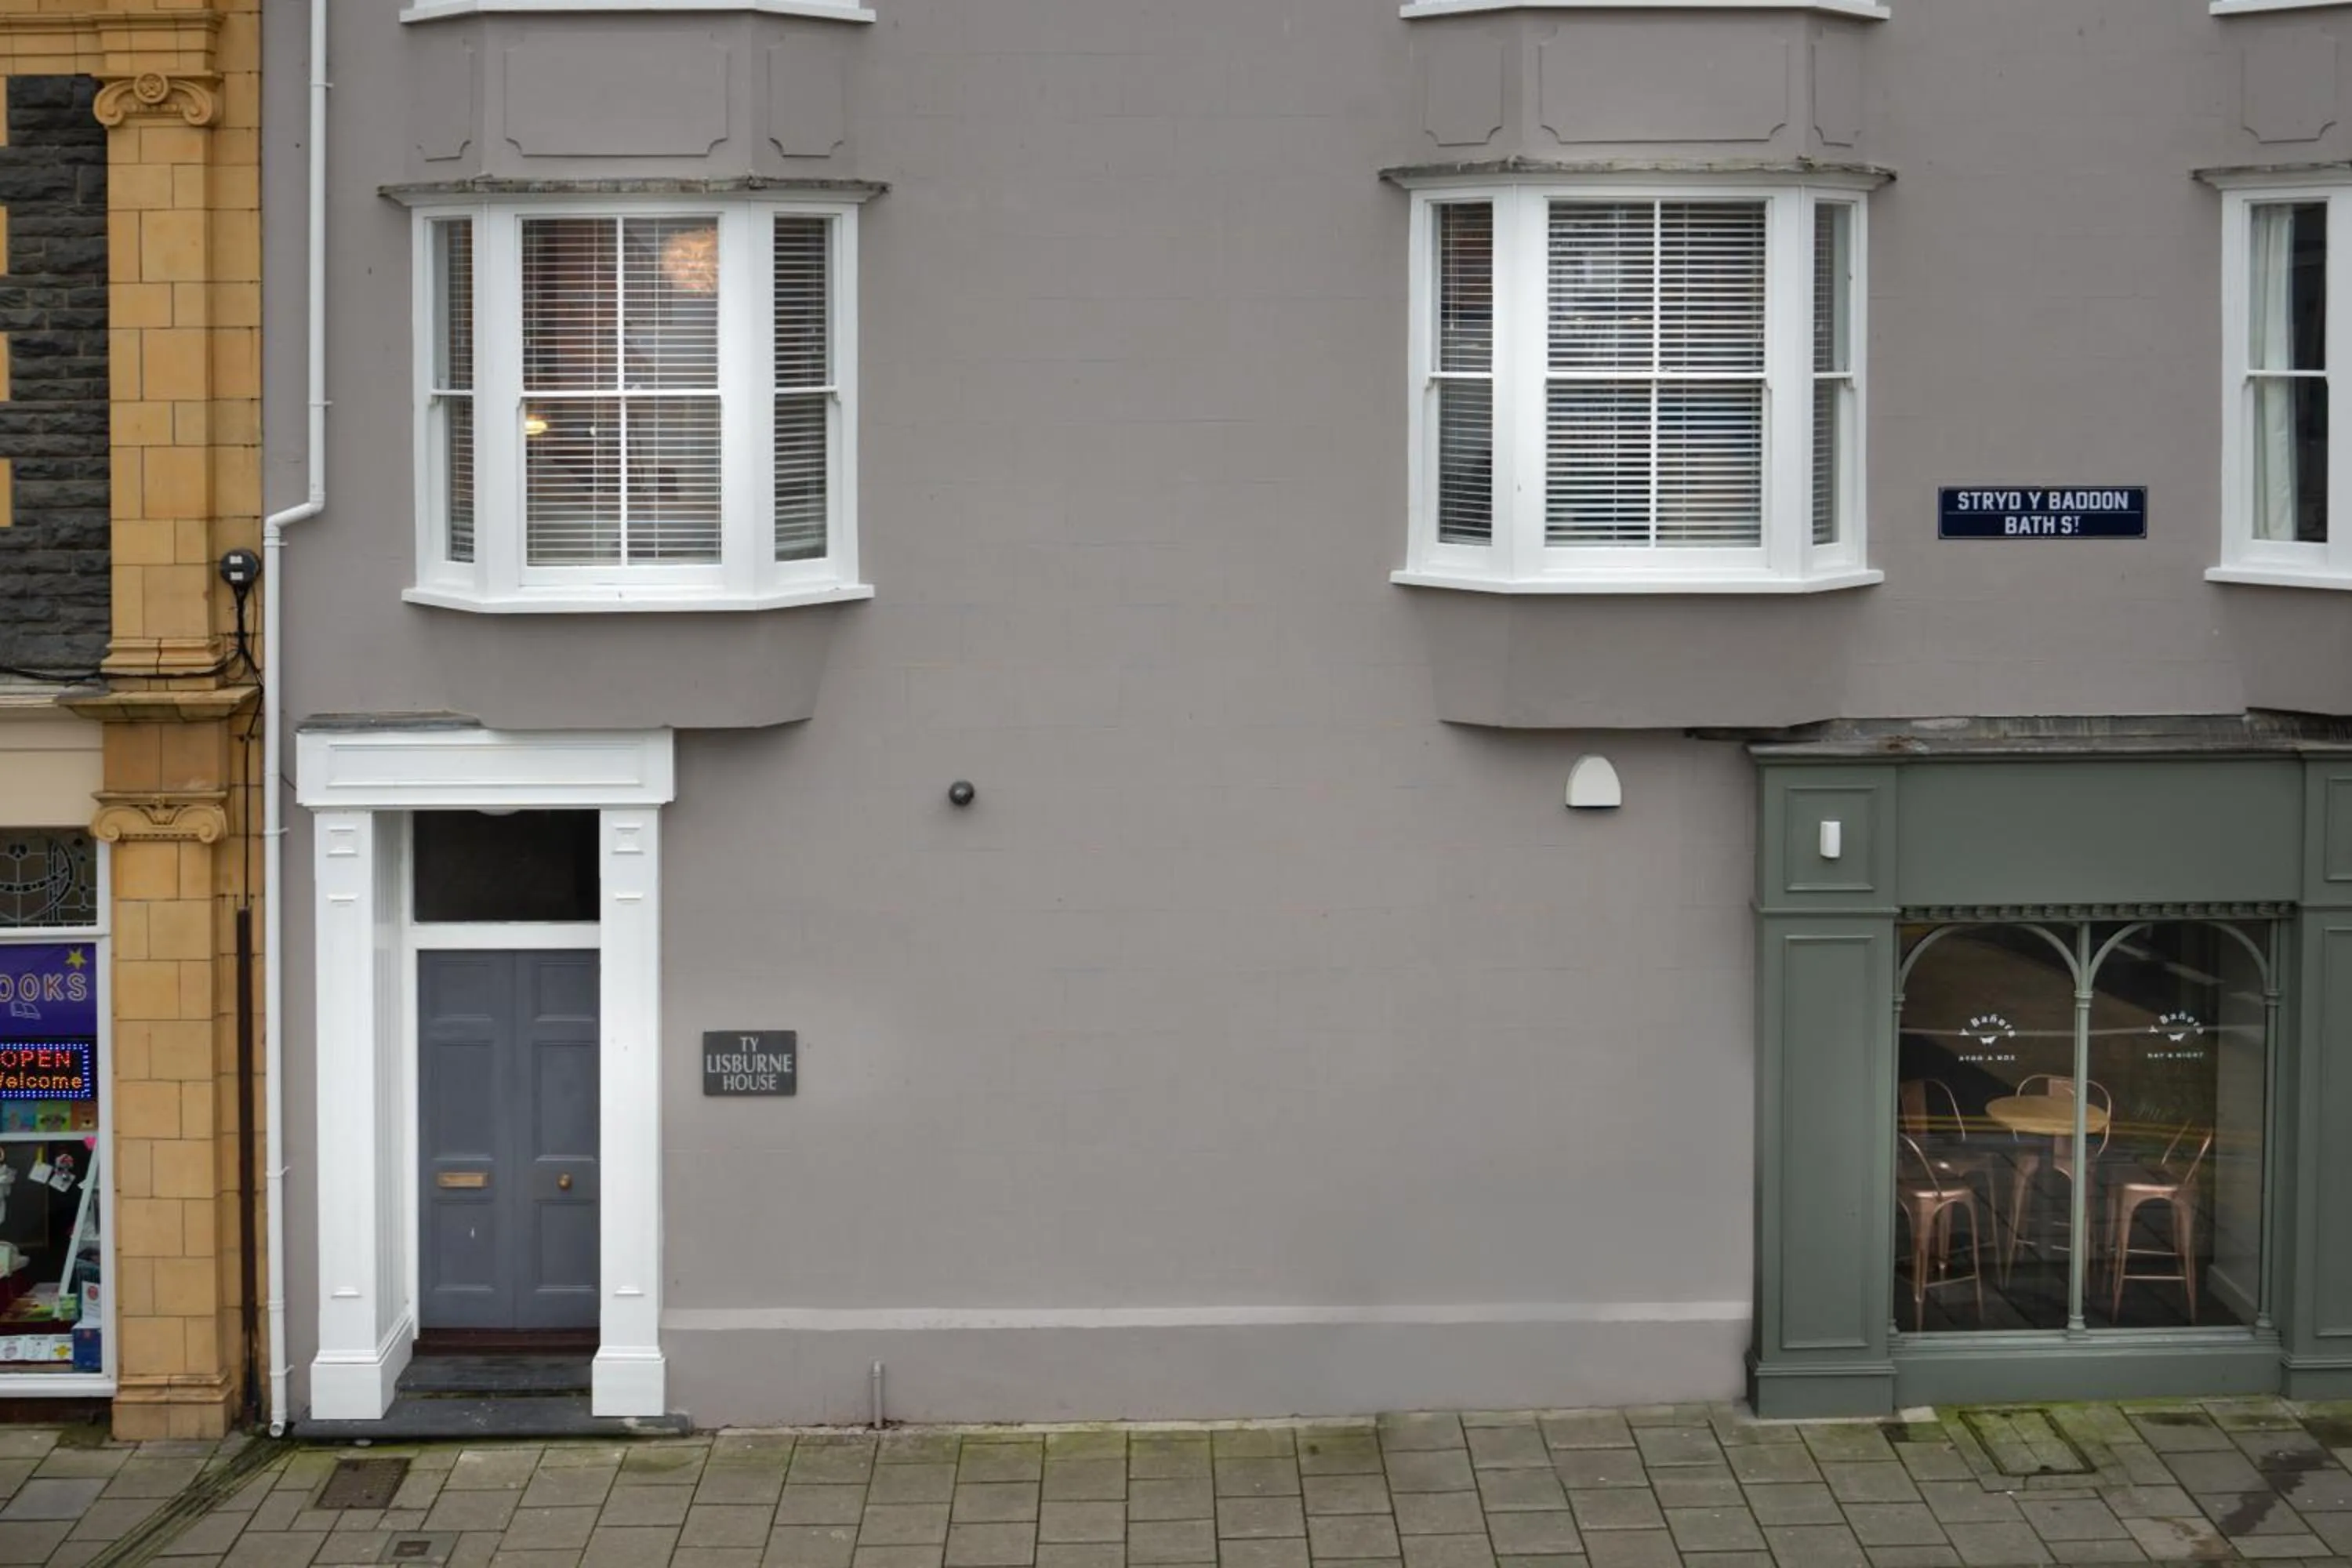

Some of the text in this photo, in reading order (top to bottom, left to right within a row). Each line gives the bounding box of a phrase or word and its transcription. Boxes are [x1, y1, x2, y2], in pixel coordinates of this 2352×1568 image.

[1958, 492, 2129, 510] STRYD Y BADDON
[2005, 516, 2056, 534] BATH
[739, 1036, 759, 1052] TY
[1, 1050, 71, 1068] OPEN
[706, 1053, 793, 1073] LISBURNE
[722, 1073, 777, 1091] HOUSE
